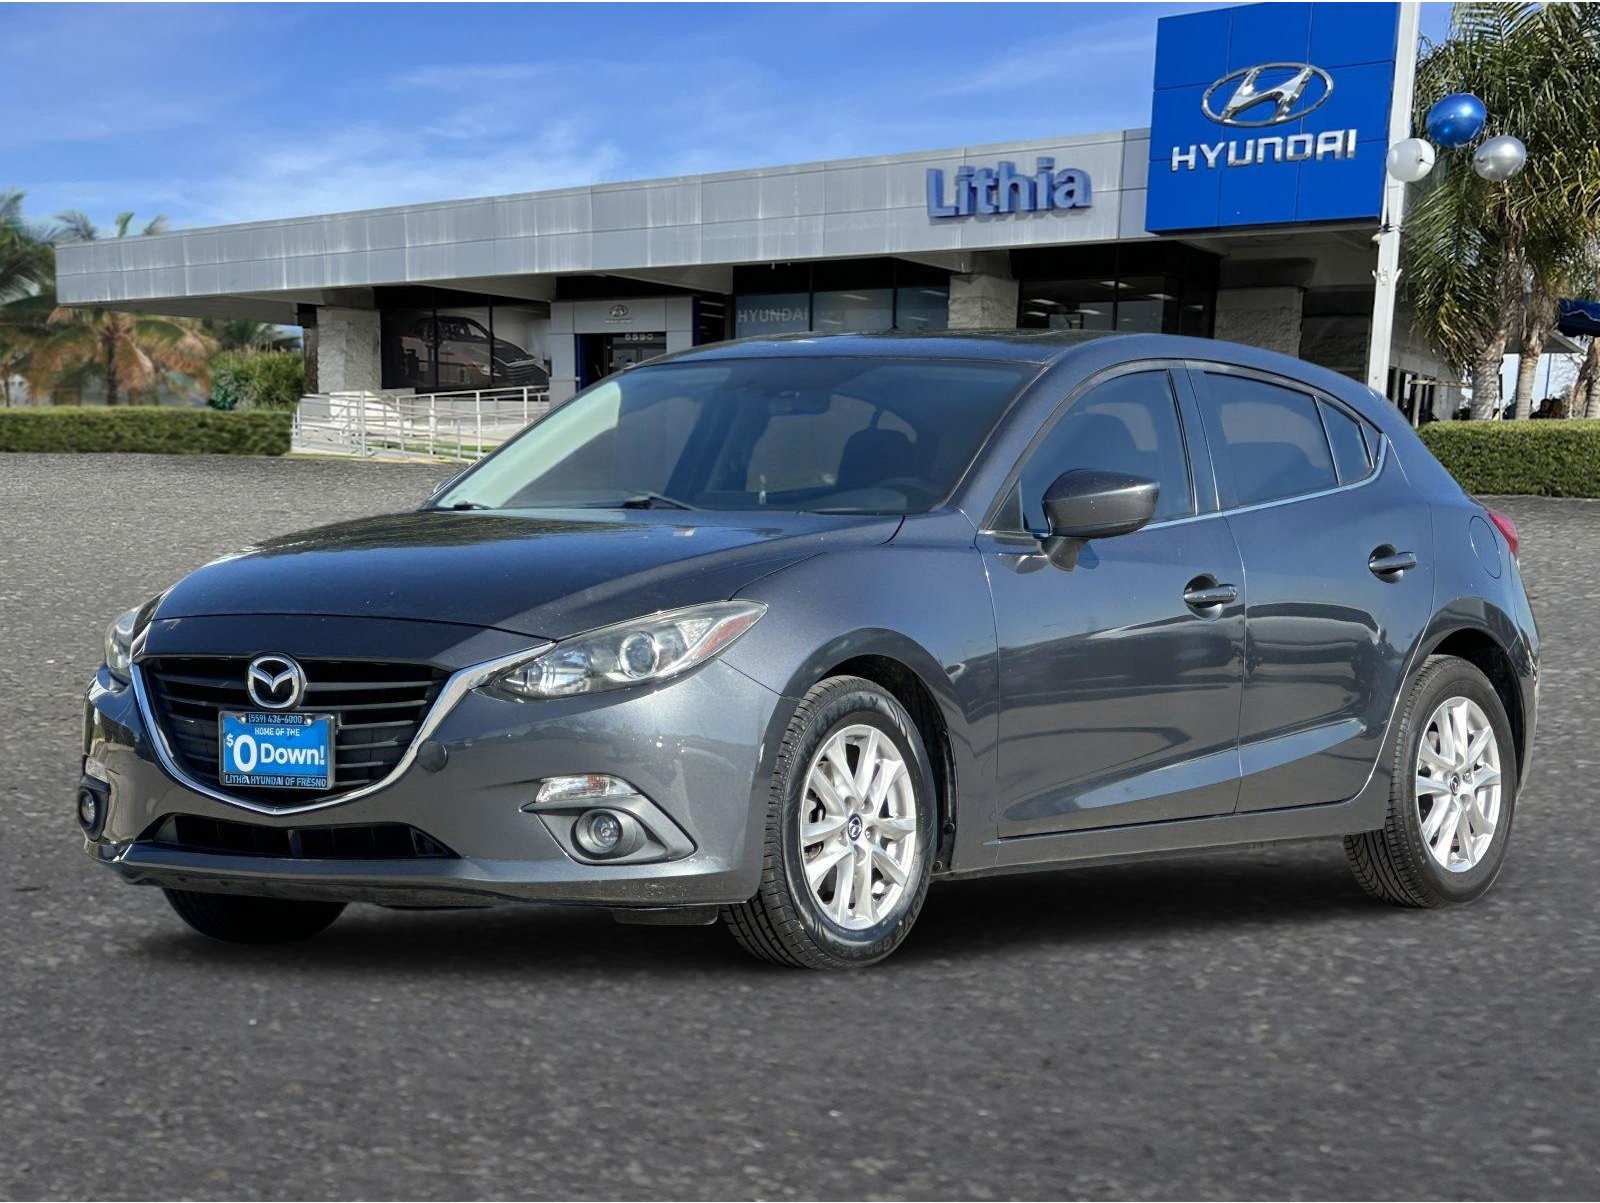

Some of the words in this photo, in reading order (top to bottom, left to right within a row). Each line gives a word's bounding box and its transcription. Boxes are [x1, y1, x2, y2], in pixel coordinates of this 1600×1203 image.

[1171, 128, 1357, 171] HYUNDAI
[926, 156, 1092, 220] Lithia
[737, 307, 809, 323] HYUNDAI
[254, 727, 274, 736] HOME
[275, 728, 285, 737] OF
[286, 728, 300, 737] THE
[260, 743, 325, 766] Down!
[250, 775, 284, 785] HYUNDAI
[285, 776, 295, 786] OF
[296, 777, 327, 787] FRESNO
